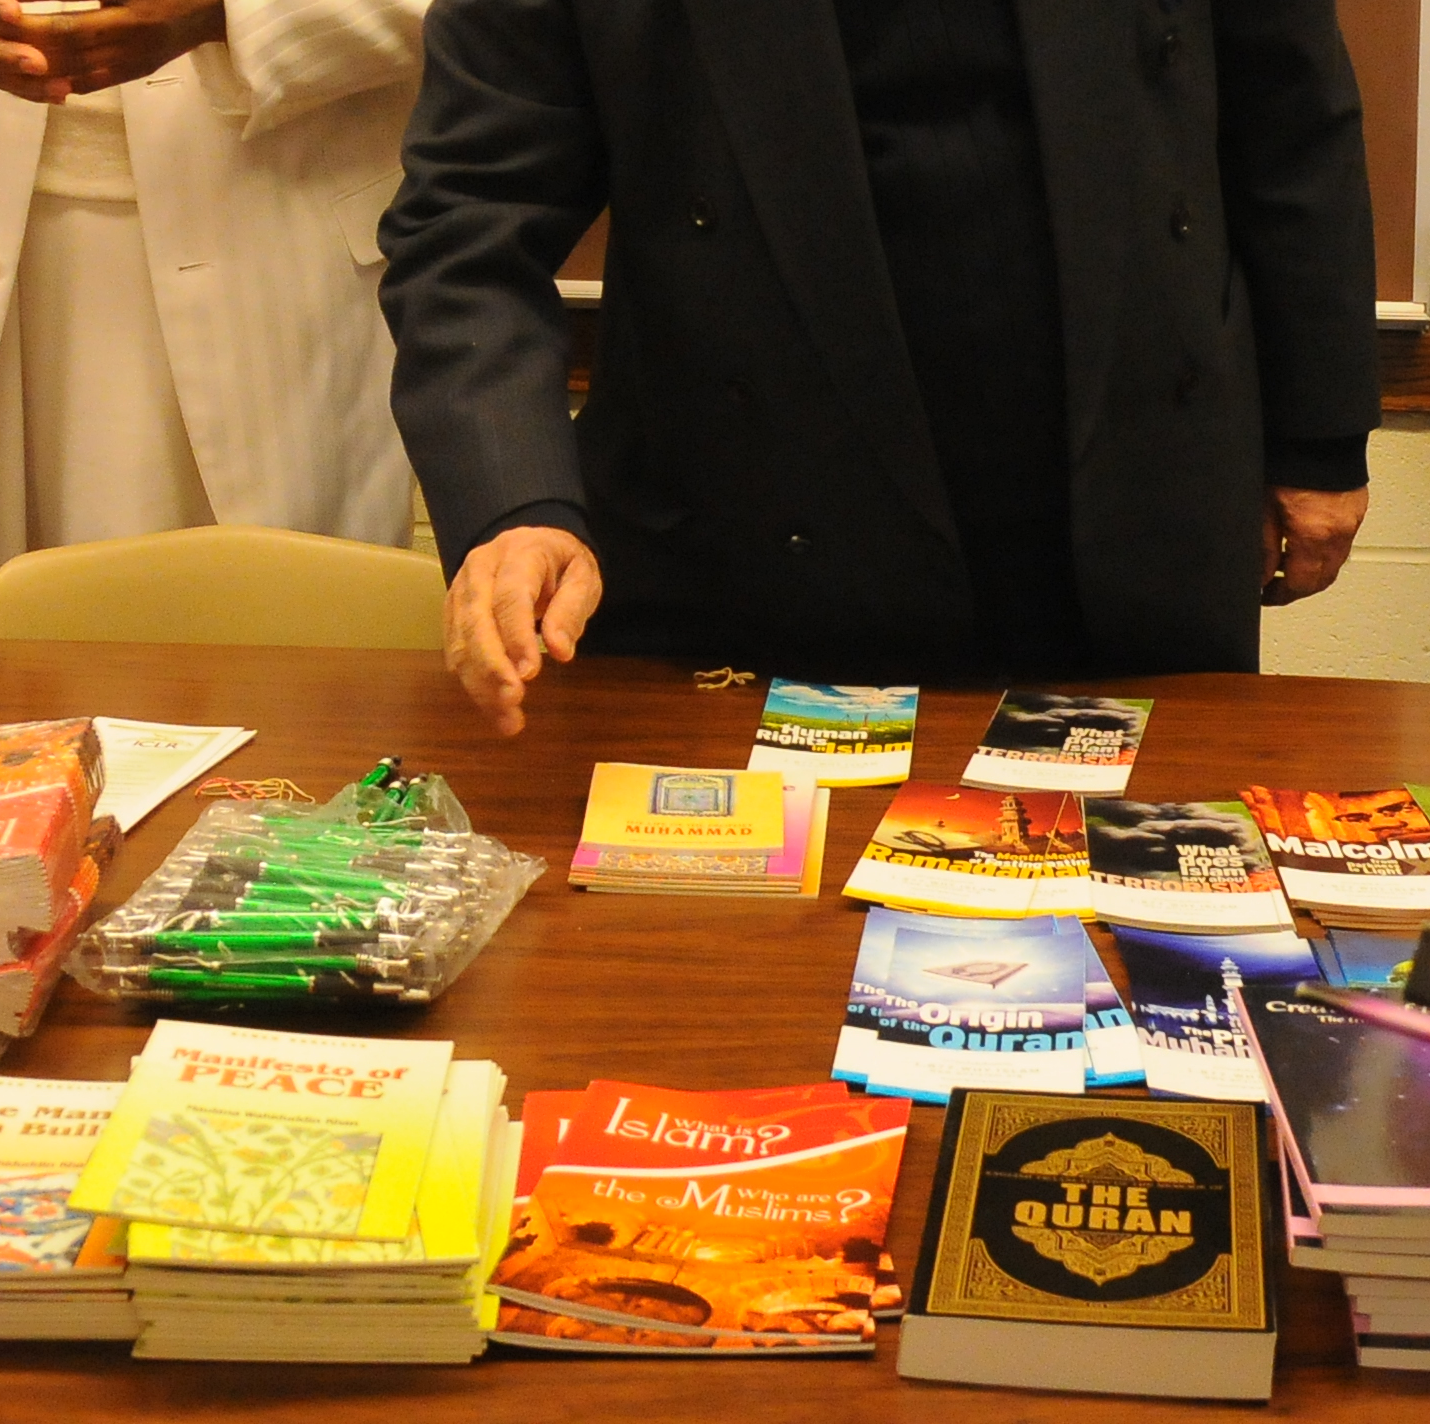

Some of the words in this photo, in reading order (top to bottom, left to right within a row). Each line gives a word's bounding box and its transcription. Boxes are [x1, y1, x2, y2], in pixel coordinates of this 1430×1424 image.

[756, 728, 828, 746] Rights
[781, 723, 868, 740] Human
[1070, 726, 1124, 738] What
[826, 741, 913, 755] Islam
[1062, 743, 1121, 754] Islam
[1065, 736, 1123, 746] does
[625, 825, 753, 836] MUHAMMAD
[973, 850, 995, 859] The
[996, 851, 1044, 861] Month
[1176, 844, 1241, 858] What
[863, 841, 1044, 879] Ramadan
[1178, 855, 1244, 867] does
[1180, 865, 1247, 877] Islam
[847, 1003, 865, 1014] of
[883, 994, 919, 1009] The
[919, 1002, 1044, 1033] Origin
[879, 1016, 899, 1028] of
[901, 1019, 931, 1033] the
[928, 1025, 1086, 1053] Quran
[1181, 1025, 1212, 1038] The
[172, 1047, 355, 1077] Manifesto
[368, 1067, 410, 1080] of
[178, 1062, 385, 1100] PEACE
[19, 1122, 104, 1137] Buil
[604, 1096, 792, 1156] Islam?
[674, 1117, 731, 1135] What
[735, 1123, 753, 1136] is
[593, 1178, 647, 1204] the
[655, 1179, 873, 1225] Muslims?
[736, 1187, 790, 1204] Who
[796, 1192, 831, 1204] are
[1061, 1182, 1149, 1207] THE
[1014, 1200, 1192, 1234] QURAN
